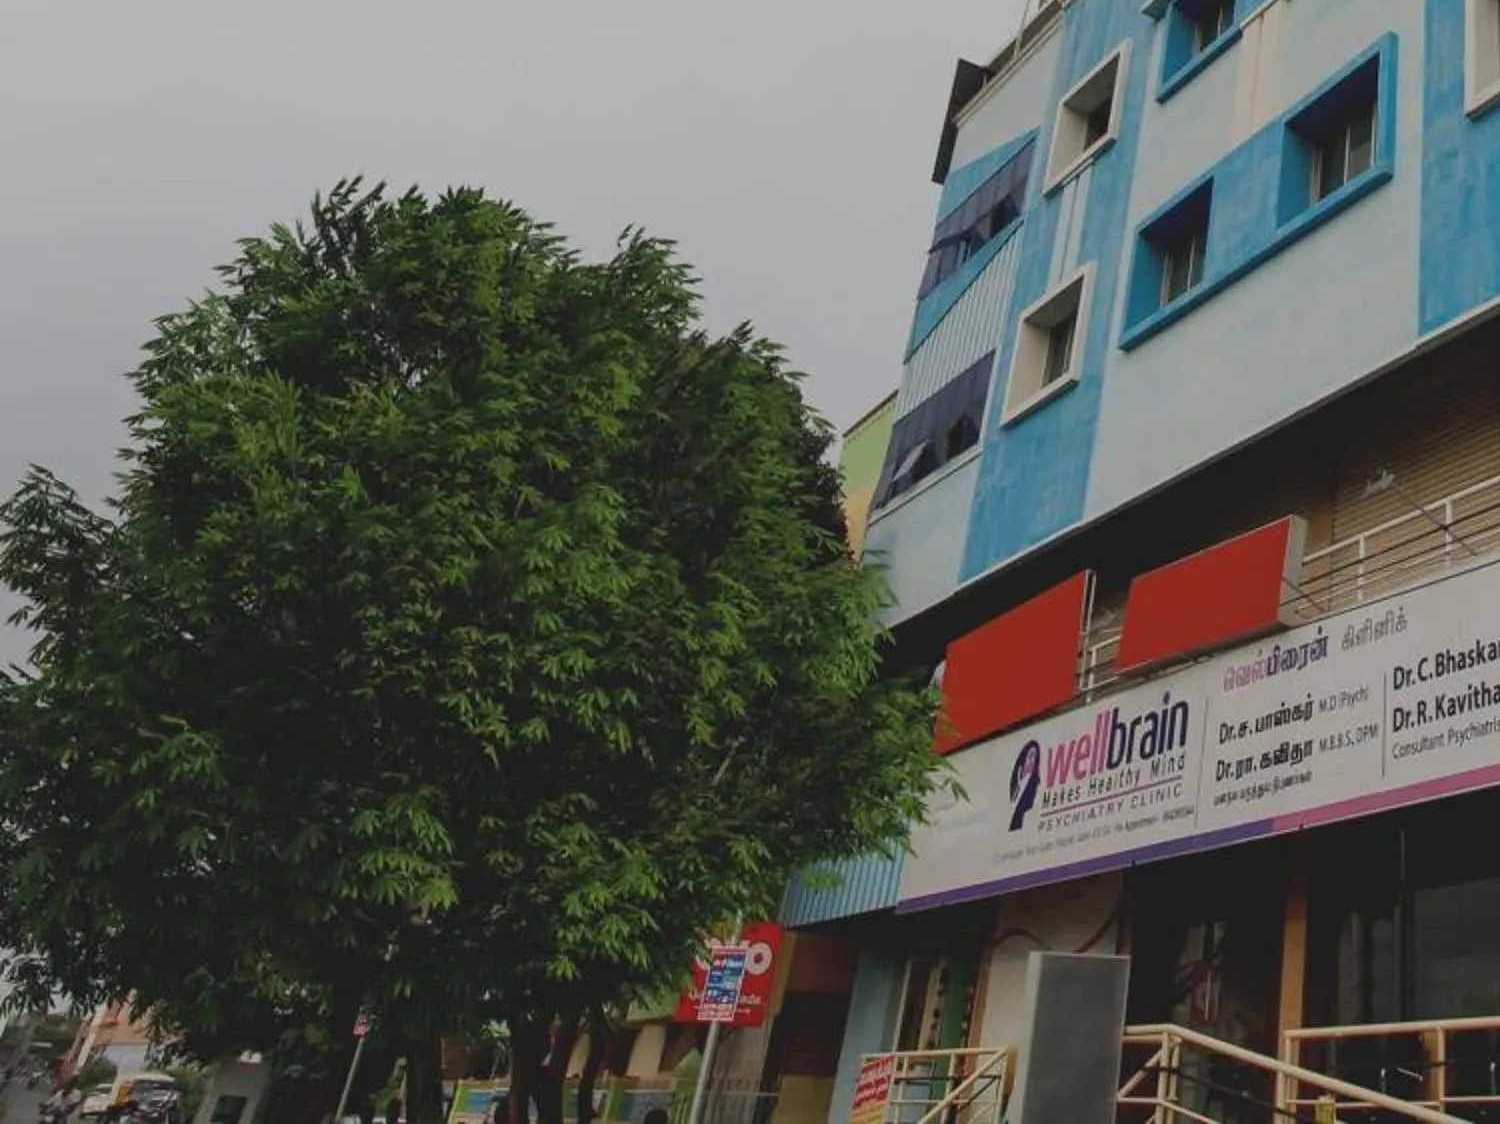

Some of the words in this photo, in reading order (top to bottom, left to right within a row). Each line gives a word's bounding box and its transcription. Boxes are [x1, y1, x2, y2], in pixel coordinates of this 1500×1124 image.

[1047, 691, 1189, 788] wellbrain
[1038, 798, 1125, 832] PSYCHIATRY
[1130, 783, 1182, 809] CLINIC
[1042, 787, 1080, 809] Makes
[1087, 767, 1140, 797] Healthy
[1151, 755, 1185, 777] Mind
